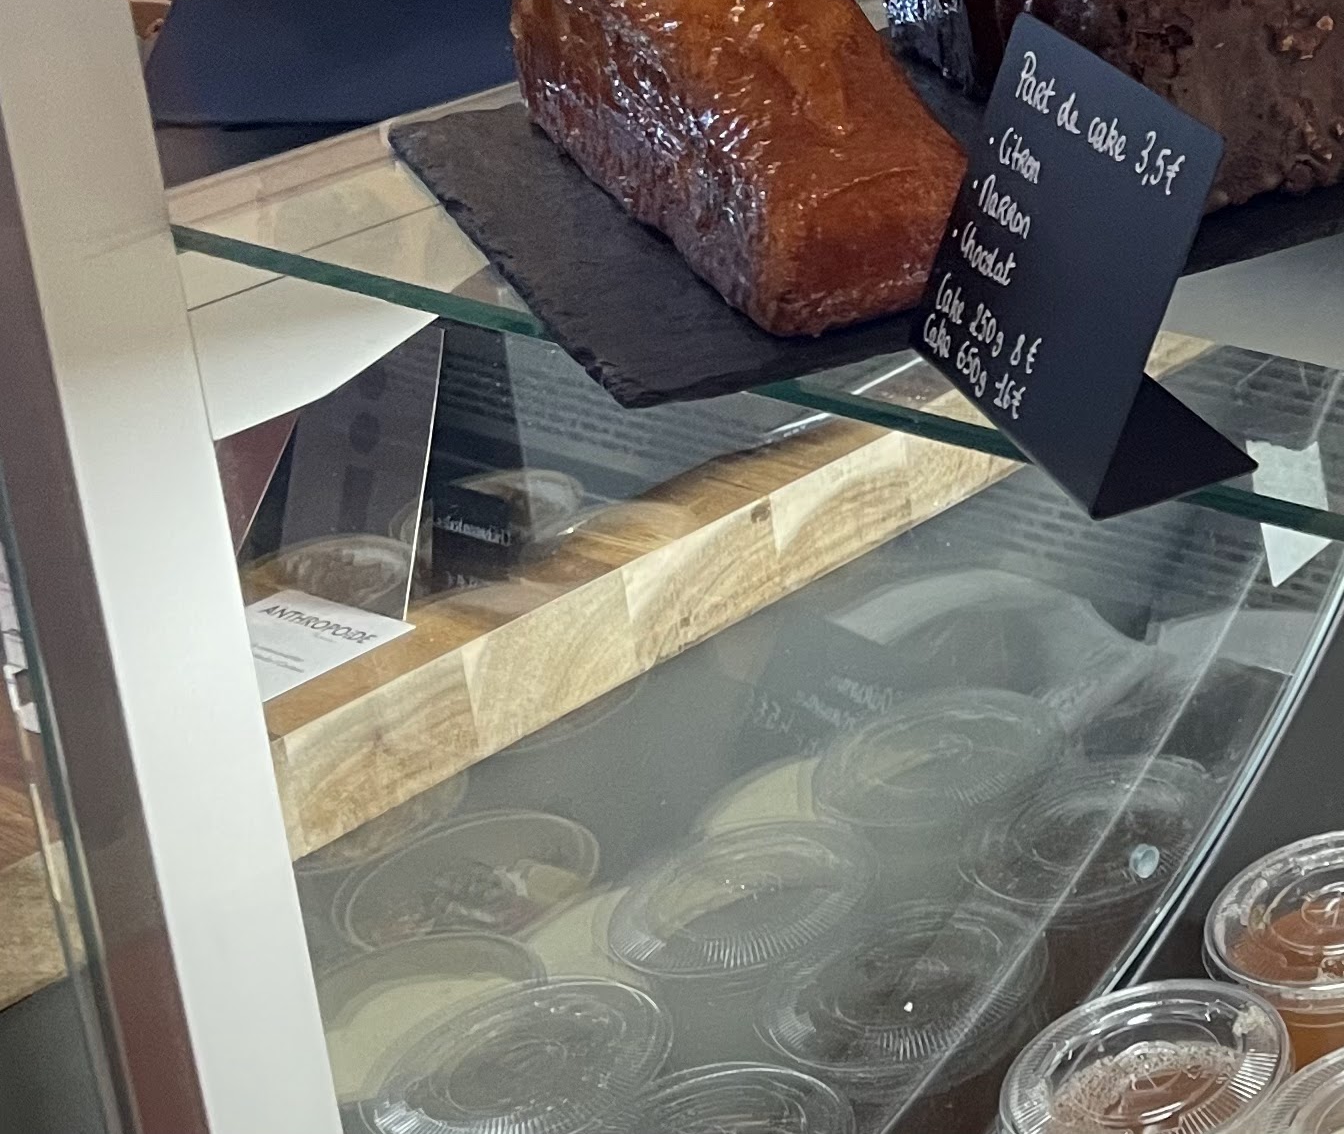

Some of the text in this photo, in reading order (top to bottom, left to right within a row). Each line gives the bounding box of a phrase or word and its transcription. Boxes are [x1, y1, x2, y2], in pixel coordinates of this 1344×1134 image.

[1057, 92, 1081, 135] de
[1088, 117, 1126, 162] cake
[935, 272, 965, 324] Cake
[923, 313, 951, 358] Cake
[956, 340, 987, 398] 650g
